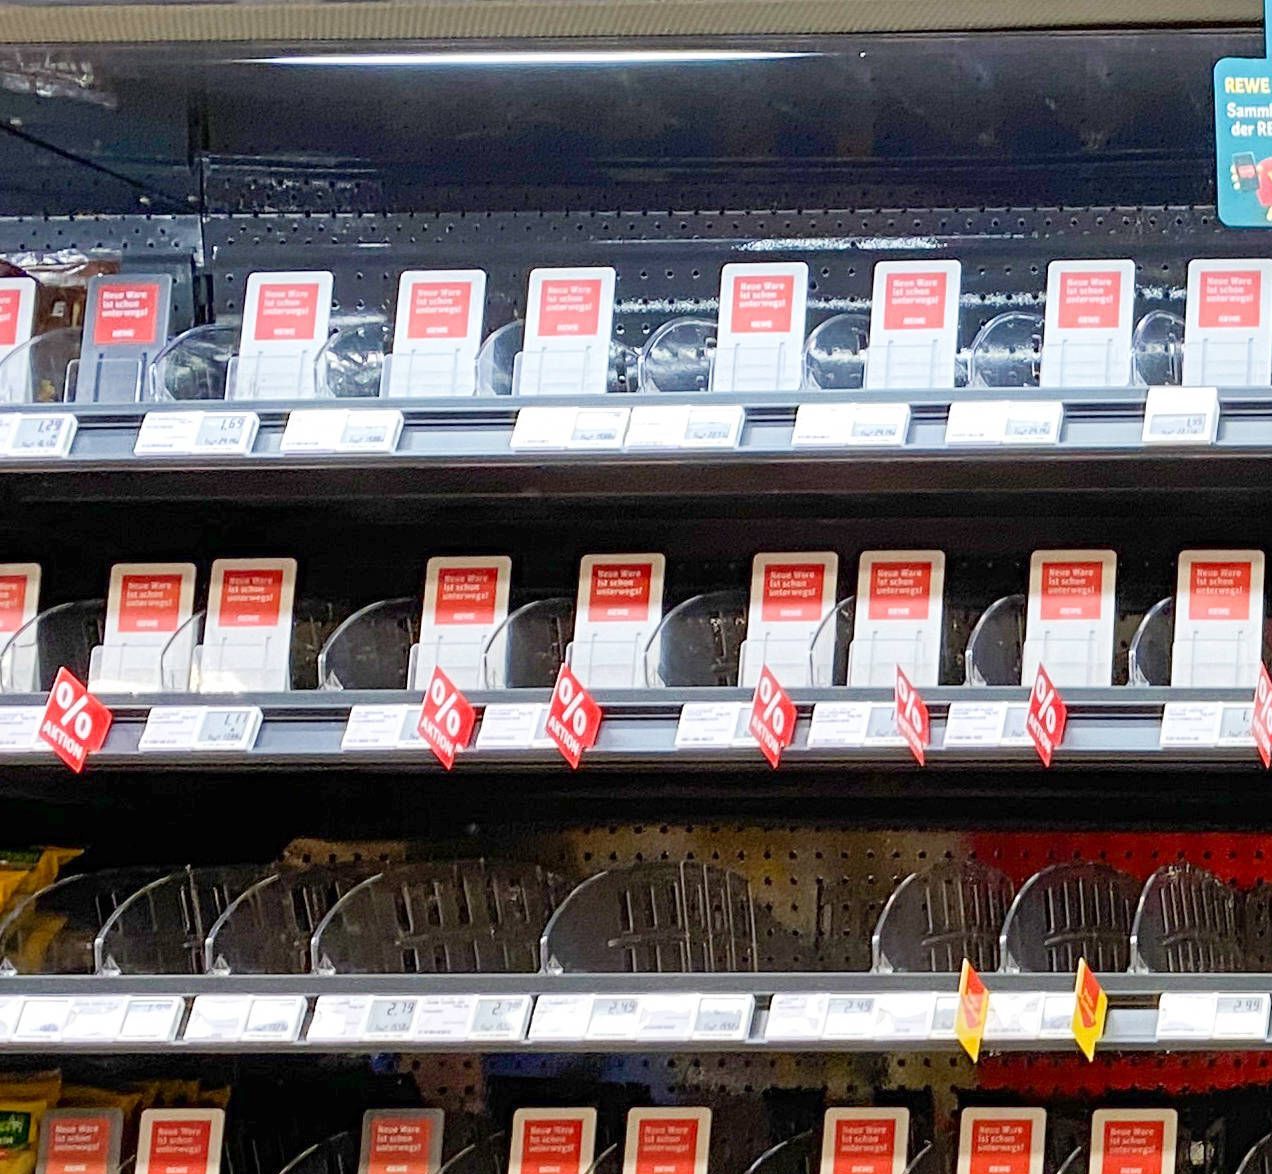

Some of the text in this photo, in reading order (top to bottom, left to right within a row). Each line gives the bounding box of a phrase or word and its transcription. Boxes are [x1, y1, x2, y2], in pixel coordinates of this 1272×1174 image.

[1224, 77, 1270, 94] REWE
[1231, 121, 1254, 136] der
[56, 681, 92, 740] %
[431, 678, 460, 737] %
[559, 677, 587, 736] %
[759, 676, 784, 736] %
[898, 676, 922, 733] %
[1036, 674, 1056, 734] %
[43, 720, 84, 760] AKTION
[421, 717, 454, 756] AKTION
[549, 717, 580, 756] AKTION
